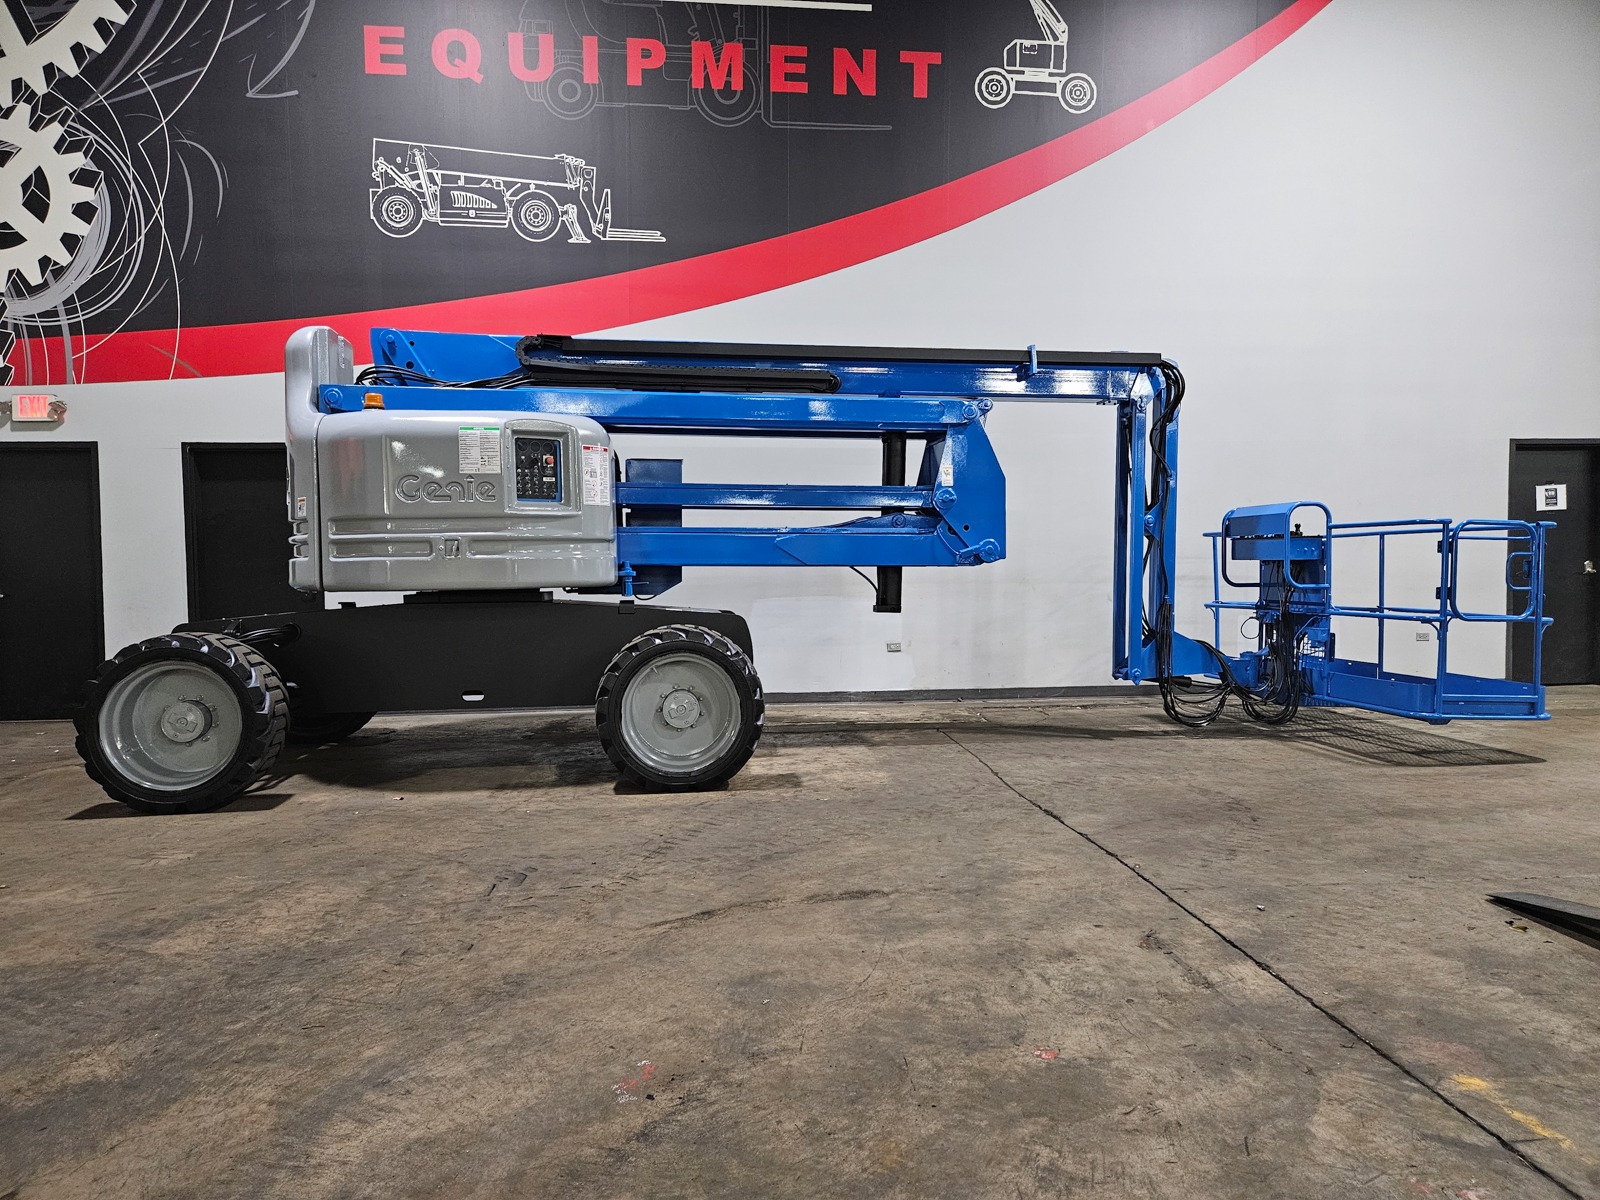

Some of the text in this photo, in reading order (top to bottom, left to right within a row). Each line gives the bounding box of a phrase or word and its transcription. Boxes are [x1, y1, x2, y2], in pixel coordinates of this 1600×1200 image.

[363, 25, 942, 98] EQUIPMENT
[18, 395, 48, 417] EXIT
[395, 474, 497, 503] Genie
